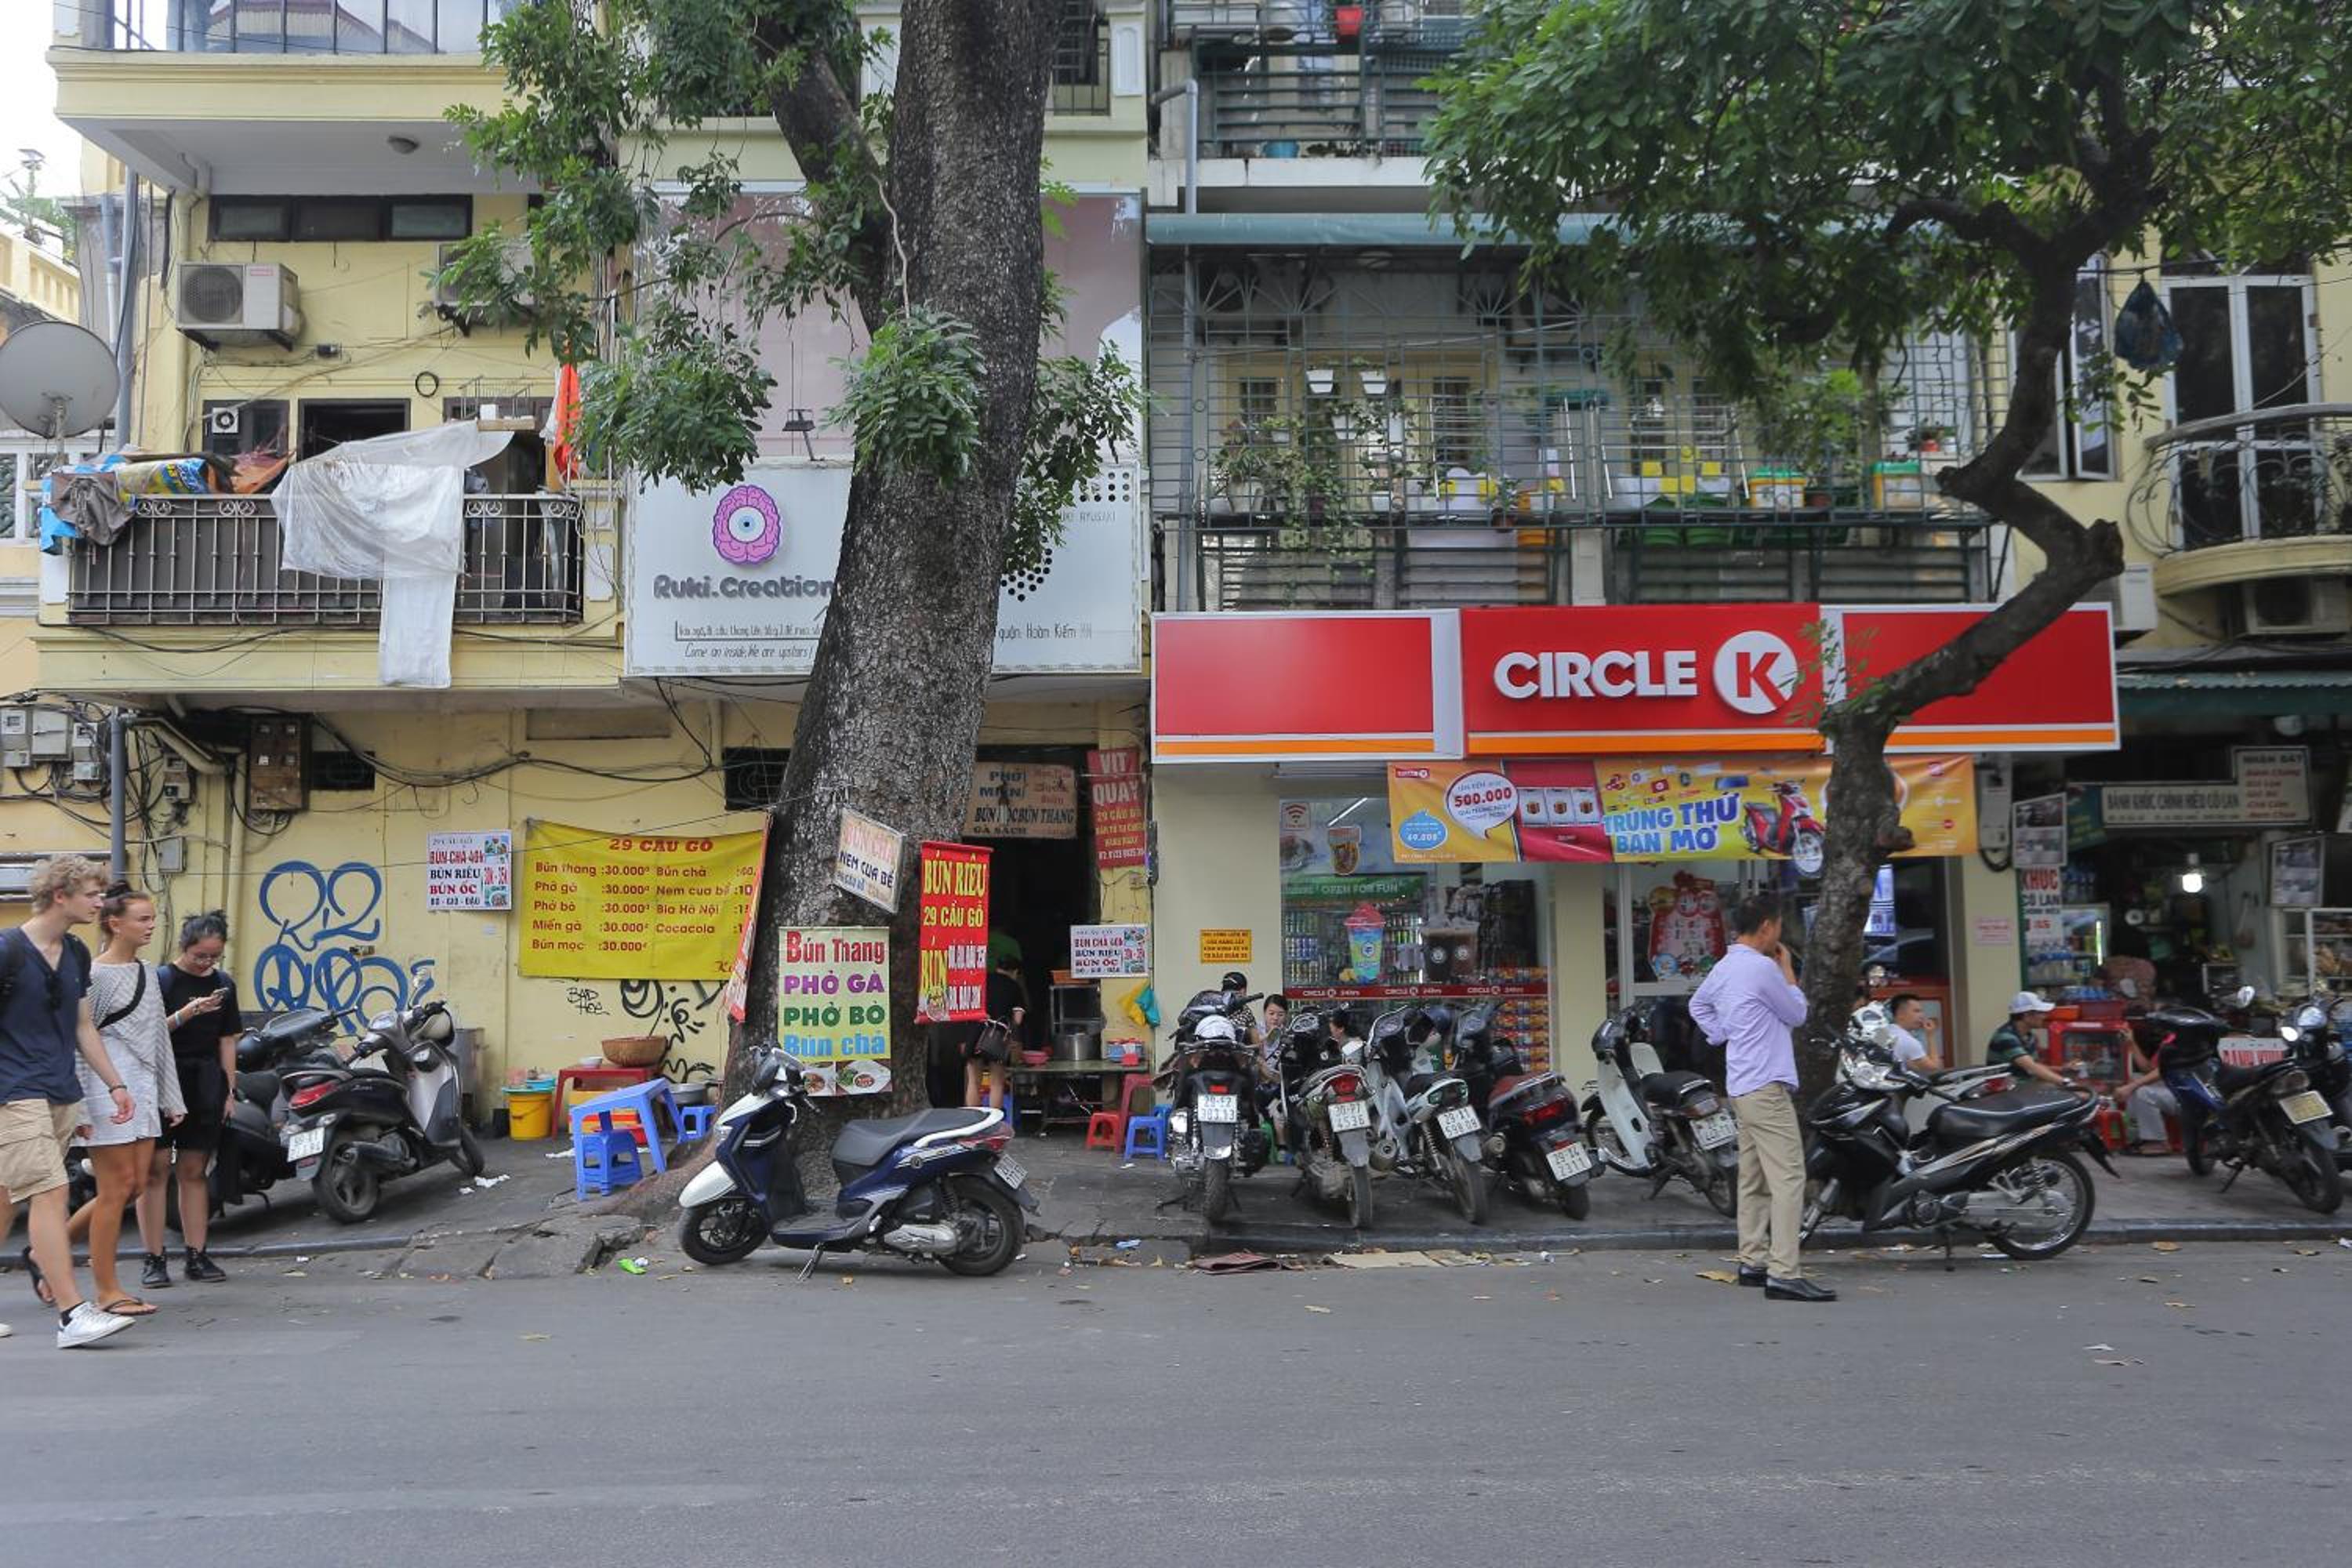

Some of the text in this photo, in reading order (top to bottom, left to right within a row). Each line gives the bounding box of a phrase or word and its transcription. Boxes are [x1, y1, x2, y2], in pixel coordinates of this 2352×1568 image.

[1493, 649, 1790, 706] CIRCLE K
[1092, 779, 1138, 806] QUAY
[1454, 787, 1512, 808] 500.000
[608, 838, 633, 851] 29
[430, 866, 452, 879] BÚN
[535, 861, 558, 873] Bún
[655, 865, 708, 877] Bún chả
[860, 862, 880, 881] CUA
[924, 849, 987, 898] BÚN RIÊU
[430, 879, 477, 895] BÚN ỐC
[561, 881, 578, 895] gà
[655, 885, 685, 896] Nem
[688, 887, 713, 896] cua
[560, 900, 576, 912] bò
[656, 904, 719, 917] Bia Hà Nội
[924, 906, 937, 926] 29
[565, 920, 583, 933] gà
[655, 922, 716, 935] Cocacola
[532, 938, 585, 953] Bún mọc
[786, 931, 886, 965] Bún Thang
[847, 969, 885, 993] GÀ
[784, 1000, 886, 1027] PHỞ BÒ
[785, 1029, 886, 1057] Bún chả
